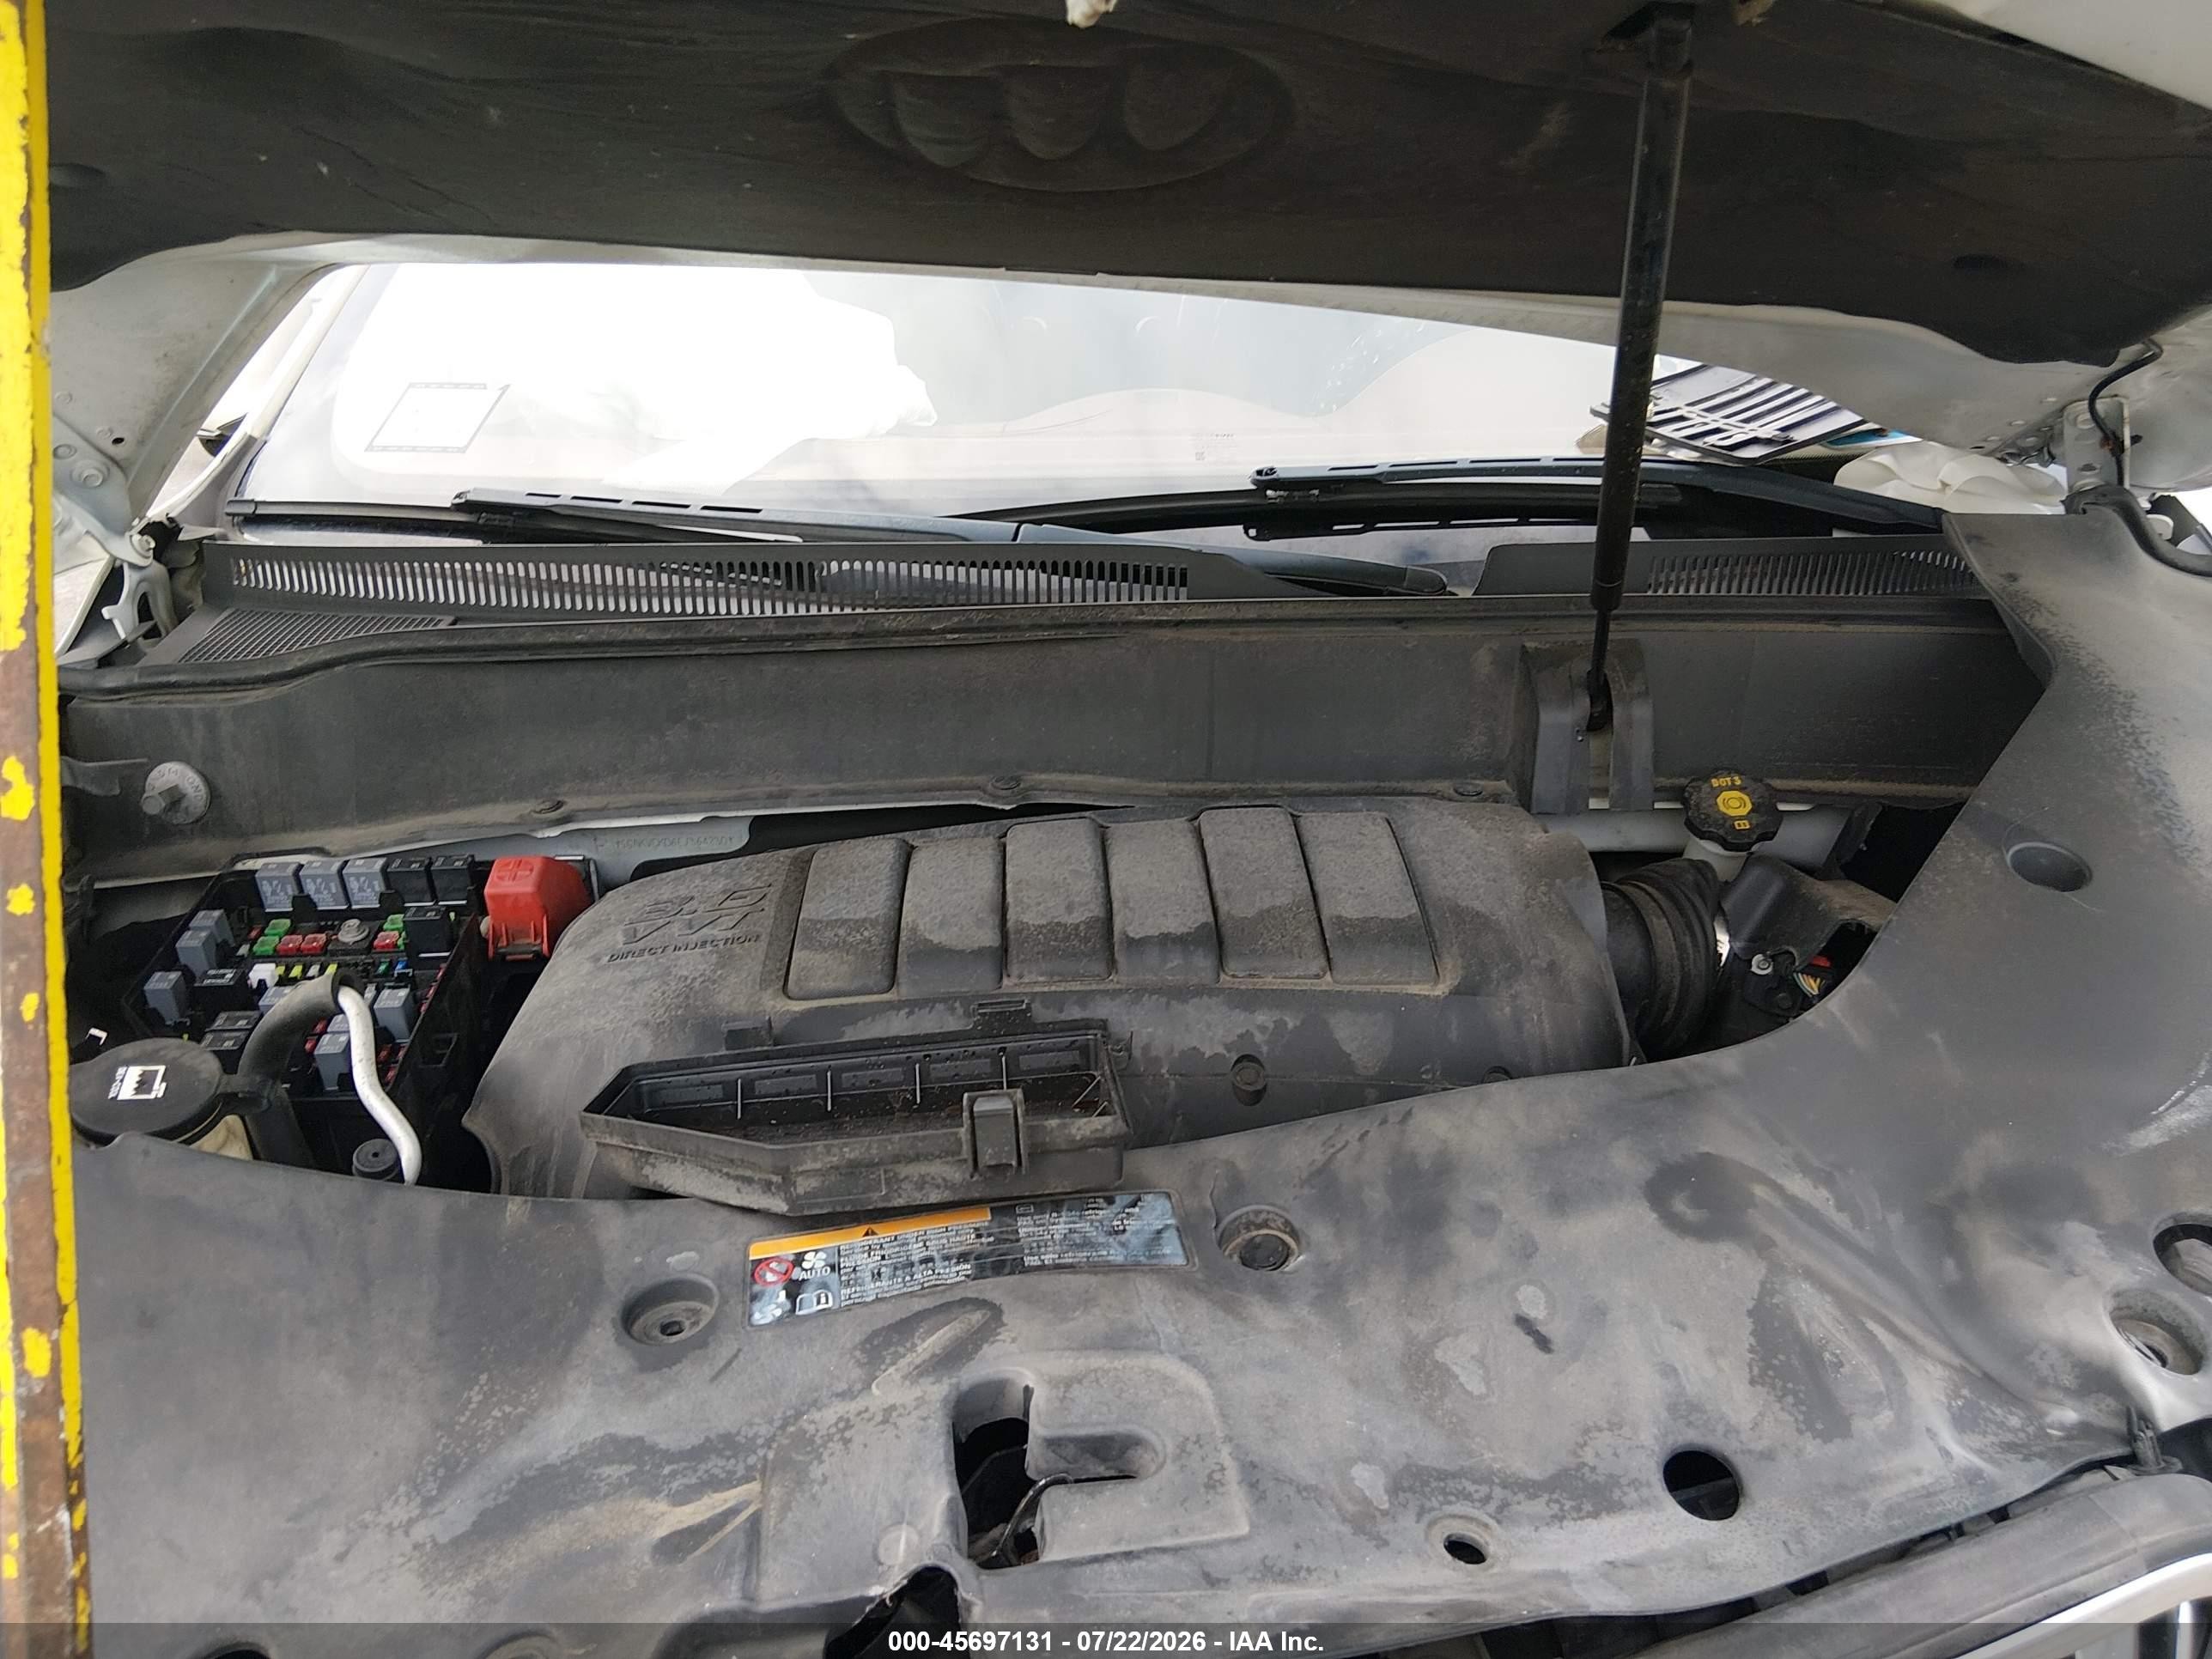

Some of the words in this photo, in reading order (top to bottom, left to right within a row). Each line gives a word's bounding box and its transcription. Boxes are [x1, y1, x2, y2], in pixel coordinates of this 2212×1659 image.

[606, 944, 670, 963] DIRECT
[671, 933, 761, 953] INJECTION
[799, 1266, 830, 1281] AUTO
